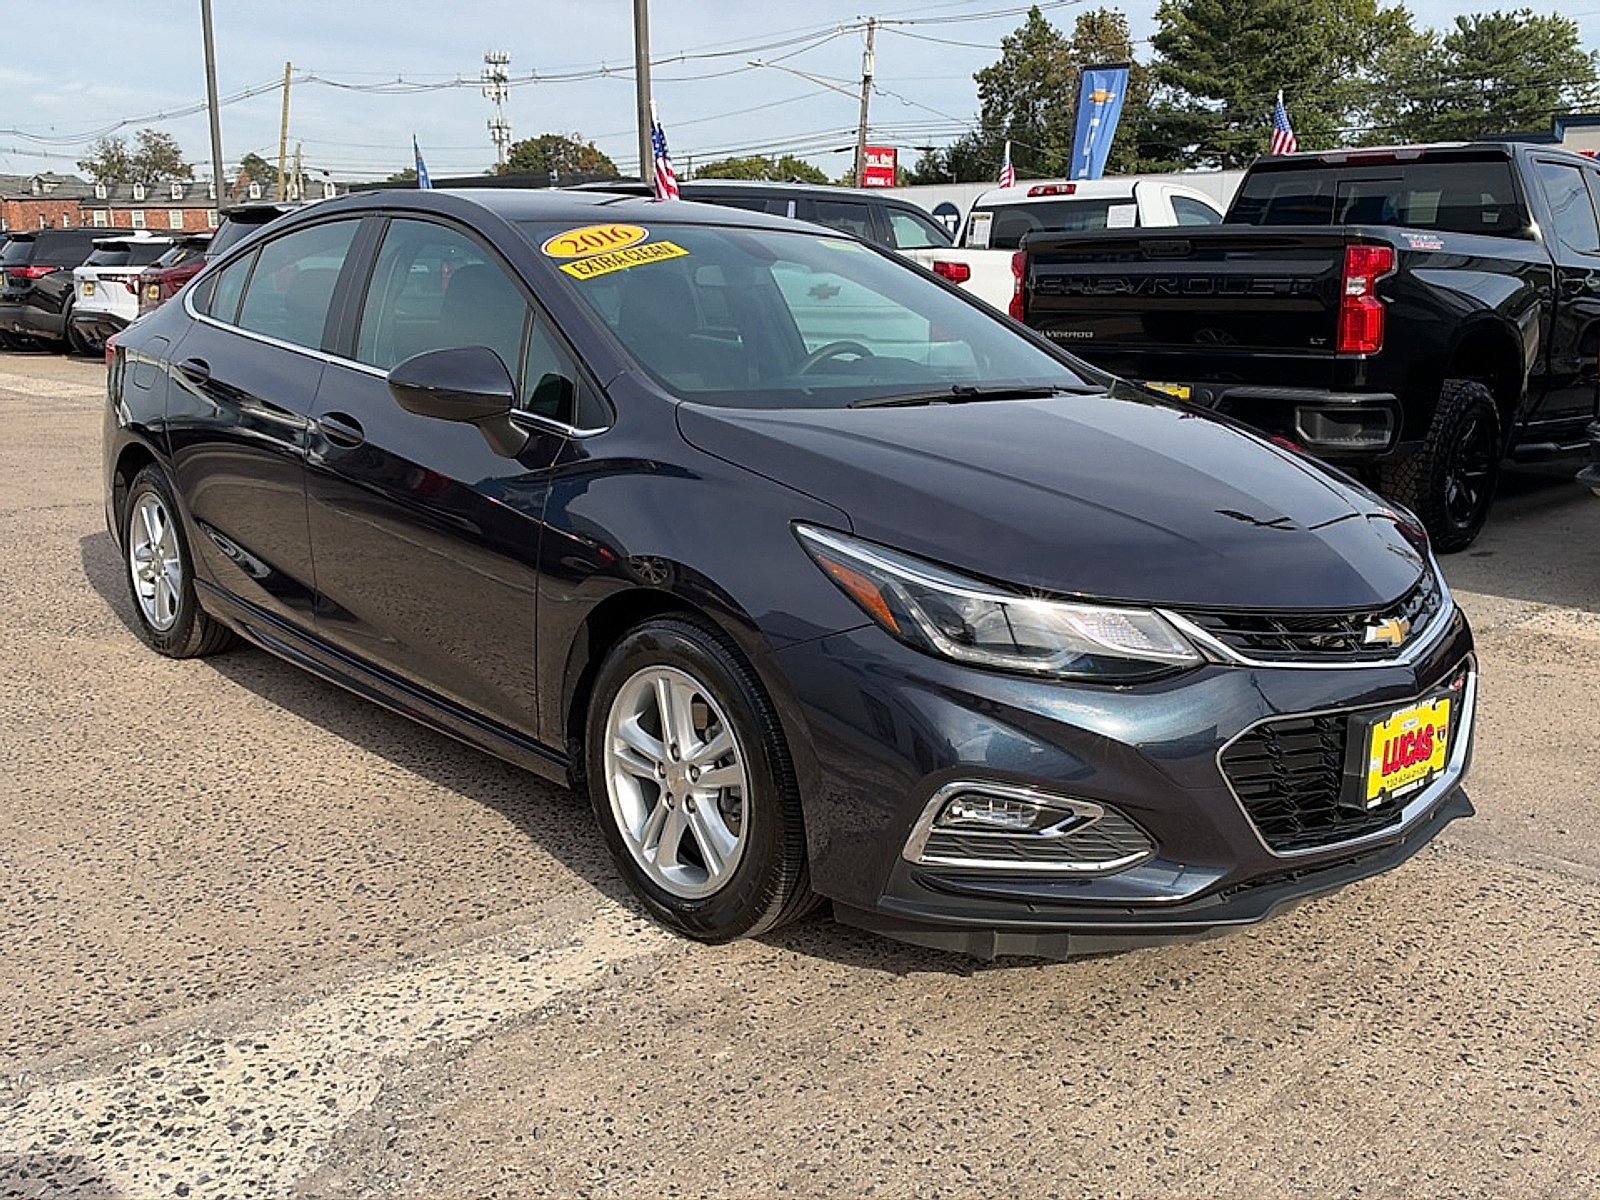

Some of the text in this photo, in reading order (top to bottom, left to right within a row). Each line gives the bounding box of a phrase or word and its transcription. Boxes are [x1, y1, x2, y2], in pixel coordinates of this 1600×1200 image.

[560, 226, 633, 254] 2016
[571, 243, 677, 275] EXTRA CLEAN
[1037, 277, 1316, 295] CHEVROLET
[1382, 724, 1435, 777] LUCAS
